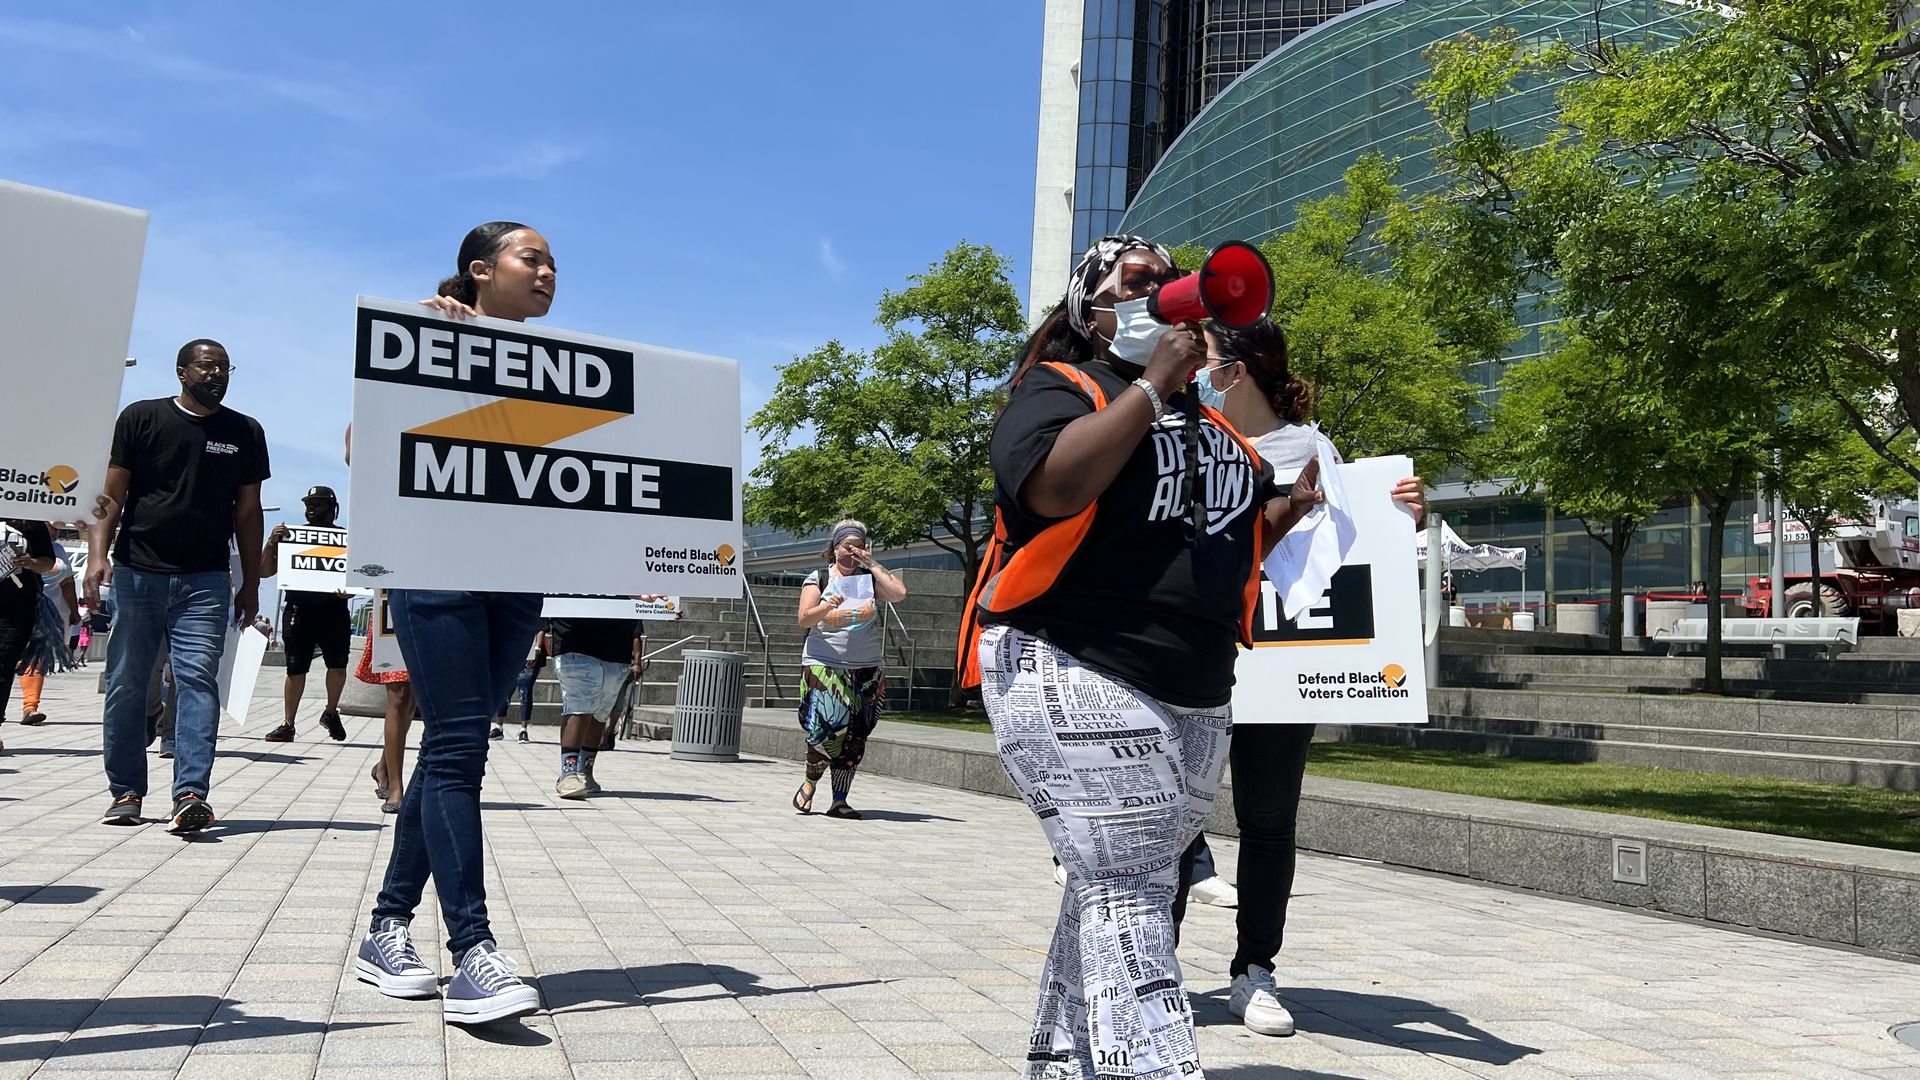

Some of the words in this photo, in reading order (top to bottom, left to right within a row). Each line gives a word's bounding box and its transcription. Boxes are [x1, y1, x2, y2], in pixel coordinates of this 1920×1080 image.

[370, 319, 612, 398] DEFEND
[0, 468, 52, 486] Black
[414, 442, 486, 496] MI
[504, 451, 661, 510] VOTE
[0, 486, 77, 506] oalition
[645, 547, 687, 560] Defend
[690, 549, 721, 561] Black
[295, 556, 317, 569] MI
[645, 561, 685, 574] Voters
[687, 563, 737, 576] Coalition
[1298, 672, 1346, 684] Defend
[1349, 672, 1387, 684] Black
[1298, 687, 1344, 699] Voters
[1347, 686, 1409, 698] Coalition
[1047, 704, 1069, 729] ENDS!
[1069, 712, 1123, 721] EXTRA!
[1073, 721, 1128, 730] EXTRA!
[1118, 791, 1177, 809] Daily
[1118, 930, 1134, 954] WAR
[1123, 953, 1142, 982] ENDS!
[1141, 960, 1168, 970] EXRA!
